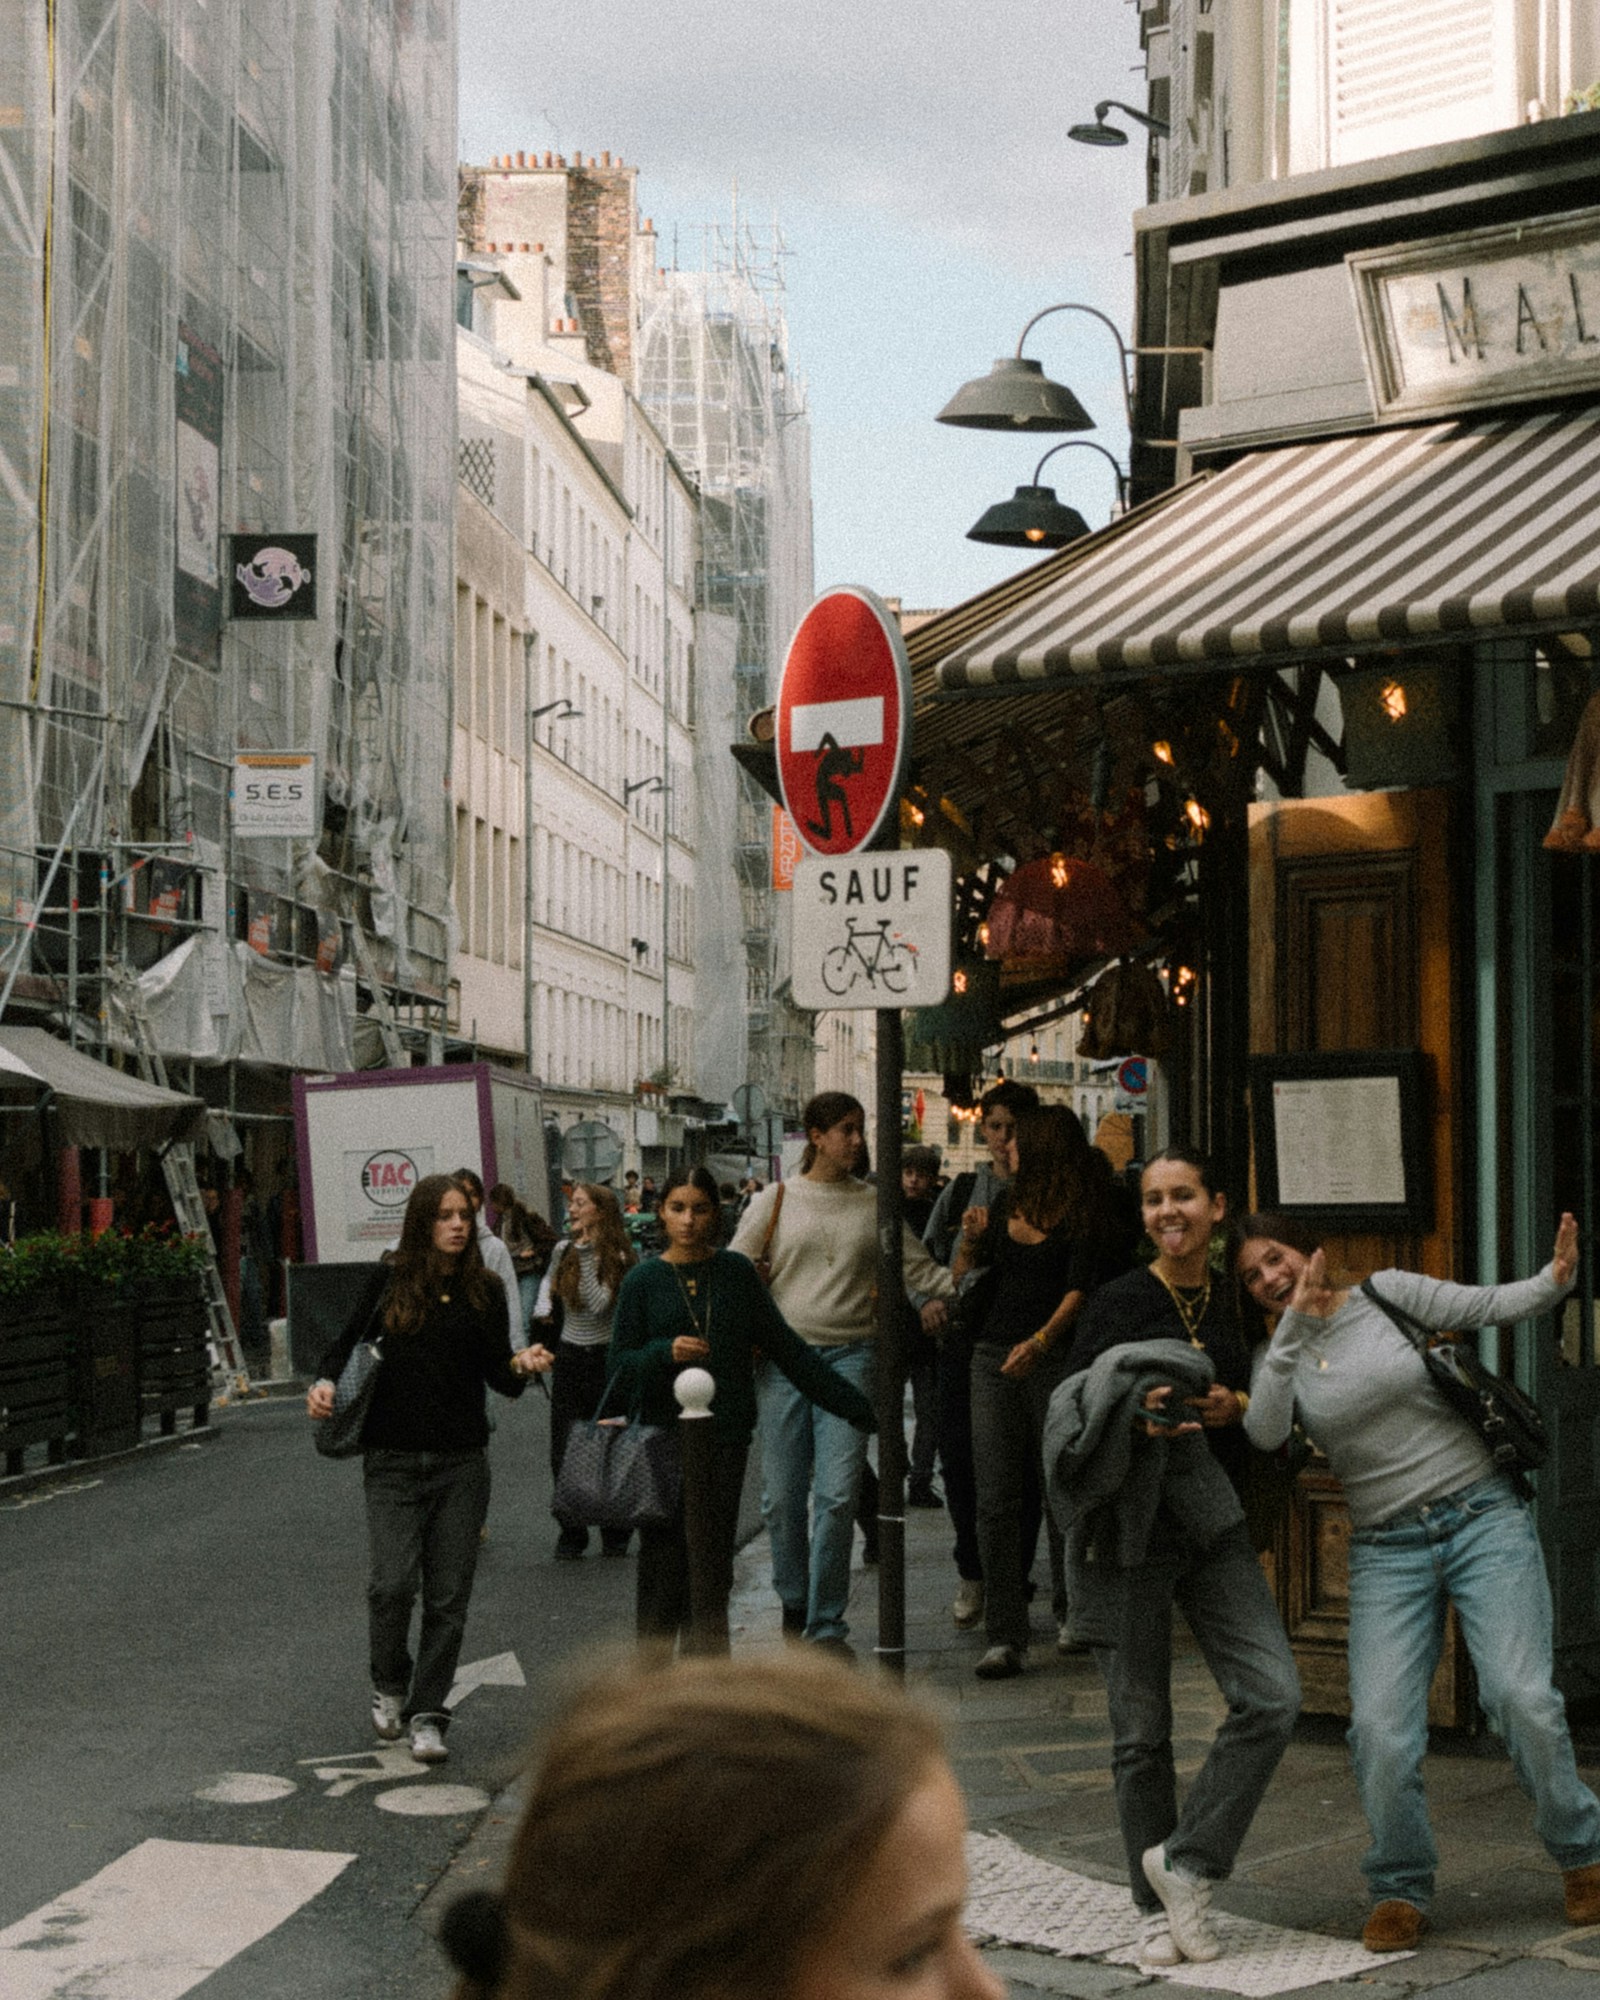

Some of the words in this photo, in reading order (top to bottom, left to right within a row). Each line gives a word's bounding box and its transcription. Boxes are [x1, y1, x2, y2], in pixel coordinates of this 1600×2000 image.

[1435, 273, 1600, 364] MAL
[245, 784, 303, 800] S.E.S
[819, 866, 919, 905] SAUF
